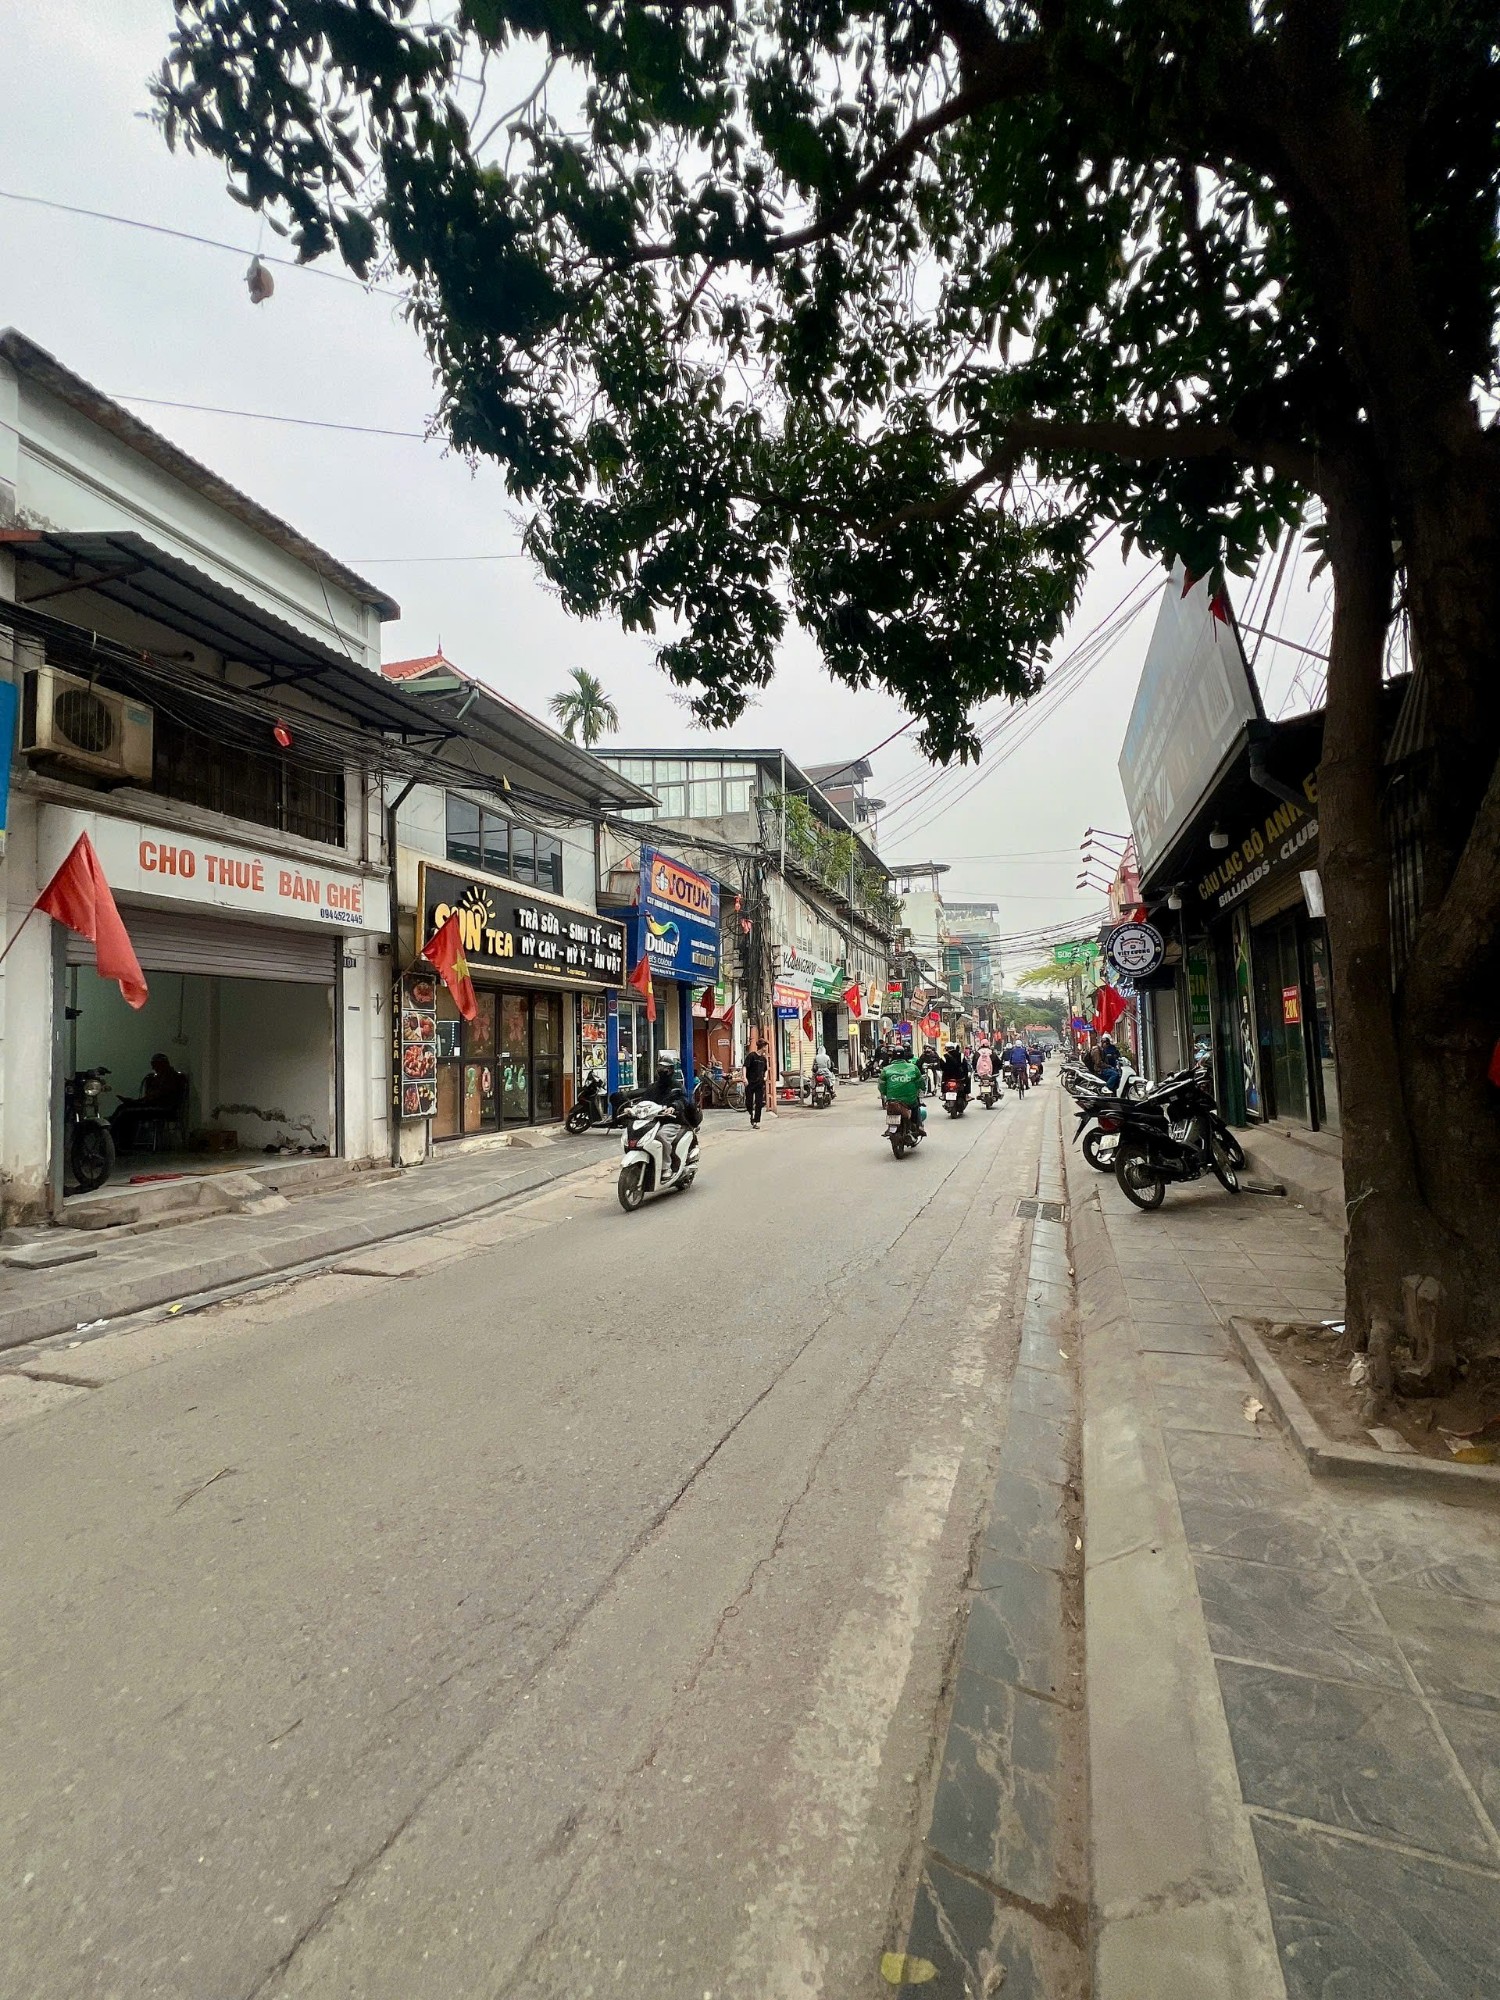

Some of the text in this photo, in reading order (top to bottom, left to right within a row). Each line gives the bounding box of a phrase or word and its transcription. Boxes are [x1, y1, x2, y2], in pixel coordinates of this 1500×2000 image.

[139, 840, 362, 913] CHO THUÊ BÀN GHẾ
[1198, 871, 1220, 900] CÂU
[1218, 851, 1243, 884] LẠC
[1242, 828, 1264, 864] BỘ
[1218, 819, 1319, 908] BILLIARDS CLUB
[668, 873, 709, 910] JOTUN
[485, 928, 514, 958] TEA
[518, 907, 539, 931] TRÀ
[540, 912, 560, 936] SỮA
[569, 922, 589, 943] SINH
[590, 925, 602, 946] TỐ
[645, 931, 676, 958] Dulux
[538, 940, 557, 960] CAY
[890, 1074, 912, 1083] Grab
